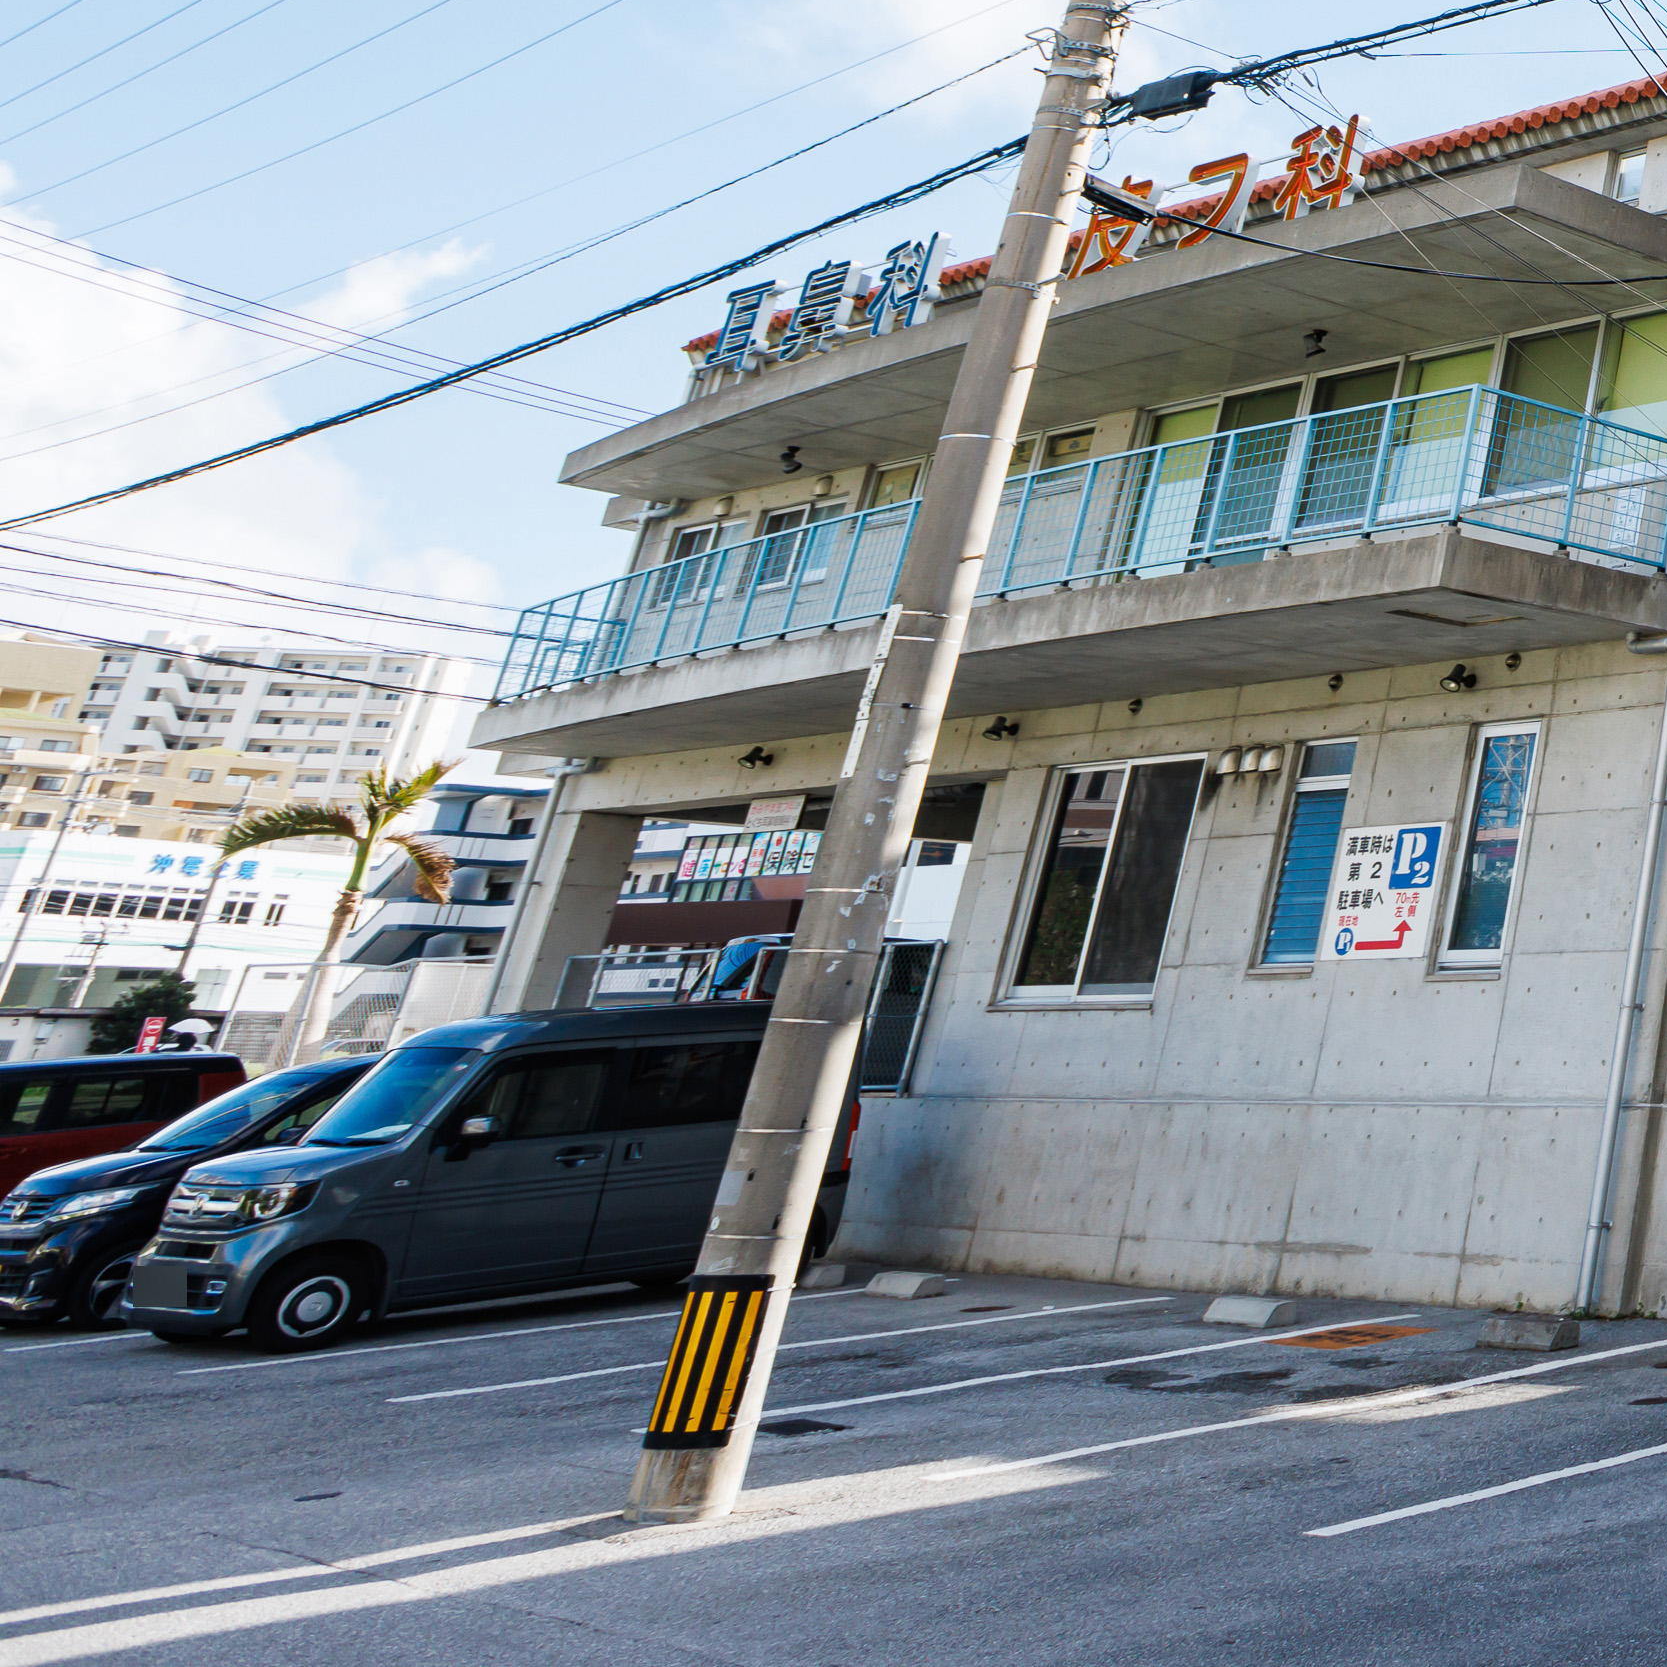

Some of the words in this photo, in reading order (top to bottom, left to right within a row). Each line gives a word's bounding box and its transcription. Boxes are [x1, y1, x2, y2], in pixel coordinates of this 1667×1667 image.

[704, 232, 950, 372] 耳鼻科
[1345, 834, 1394, 857] 満車時は
[1347, 862, 1362, 882] 第
[1370, 861, 1383, 879] 2
[1337, 888, 1384, 911] 駐車場へ
[1338, 915, 1359, 927] 現在地
